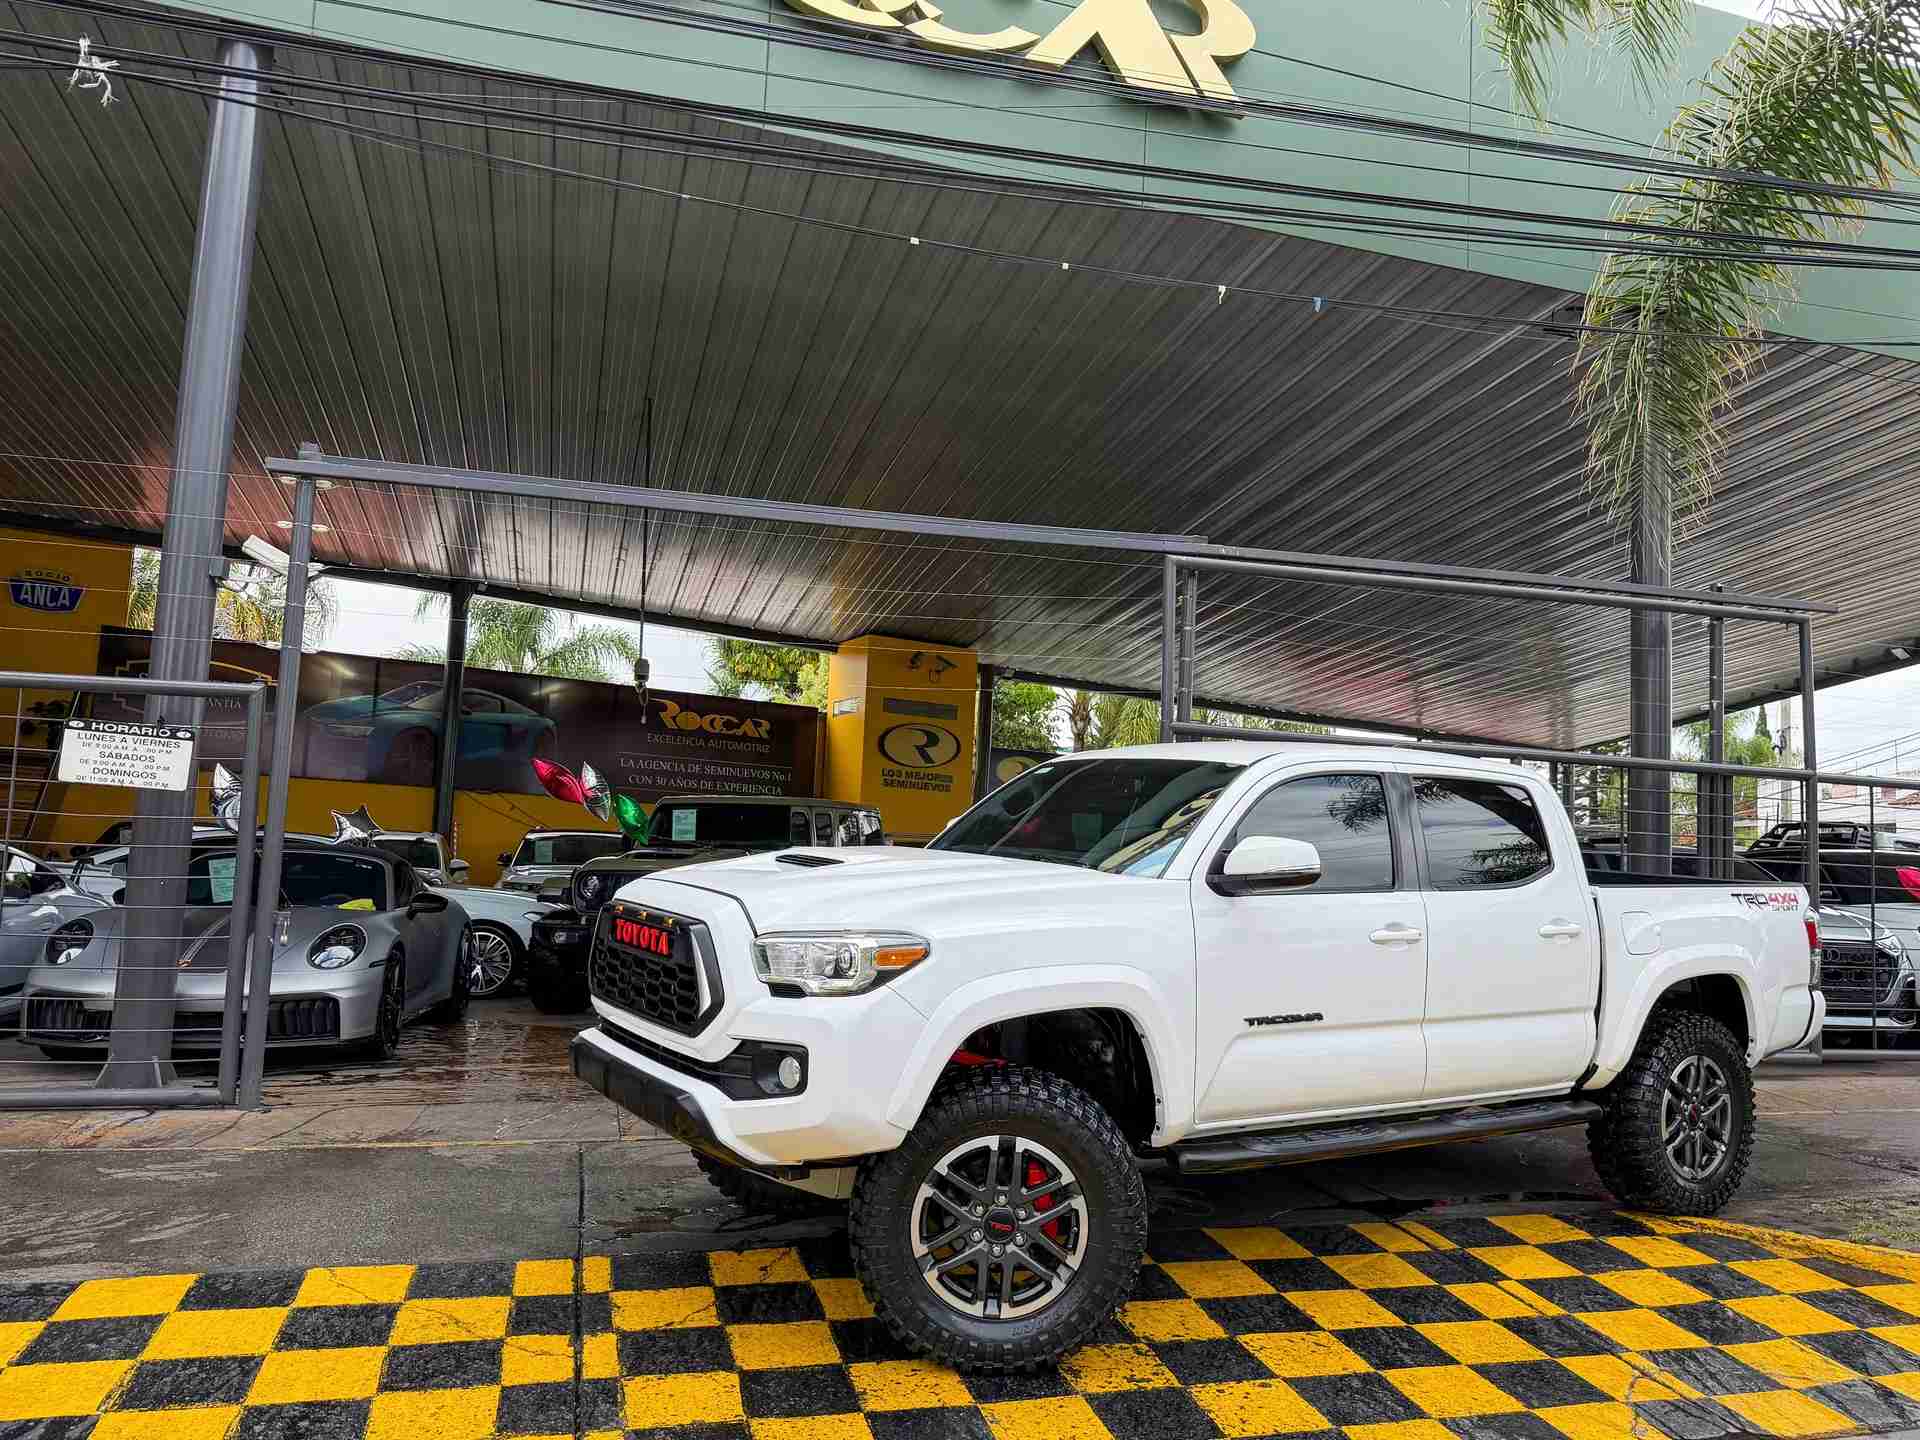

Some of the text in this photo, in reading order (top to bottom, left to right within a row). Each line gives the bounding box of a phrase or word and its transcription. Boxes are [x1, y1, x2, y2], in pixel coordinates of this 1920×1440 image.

[20, 582, 71, 607] ANCA
[650, 698, 771, 738] ROCCAR
[91, 721, 171, 737] HORARIO
[78, 731, 182, 749] LUNES A VIERNES
[647, 732, 771, 753] EXCELENCIA AUTOMOTRIZ
[98, 750, 156, 763] SABADOS
[92, 767, 158, 780] DOMINGOS
[620, 757, 636, 769] LA
[637, 759, 686, 774] AGENCIA
[688, 763, 702, 774] DE
[704, 764, 771, 780] SEMINUEVOS
[882, 769, 902, 778] LOS
[627, 775, 783, 796] CON 30 AÑOS DE EXPERIENCIA
[614, 918, 669, 956] TOYOTA
[1243, 1012, 1324, 1027] TACOMA
